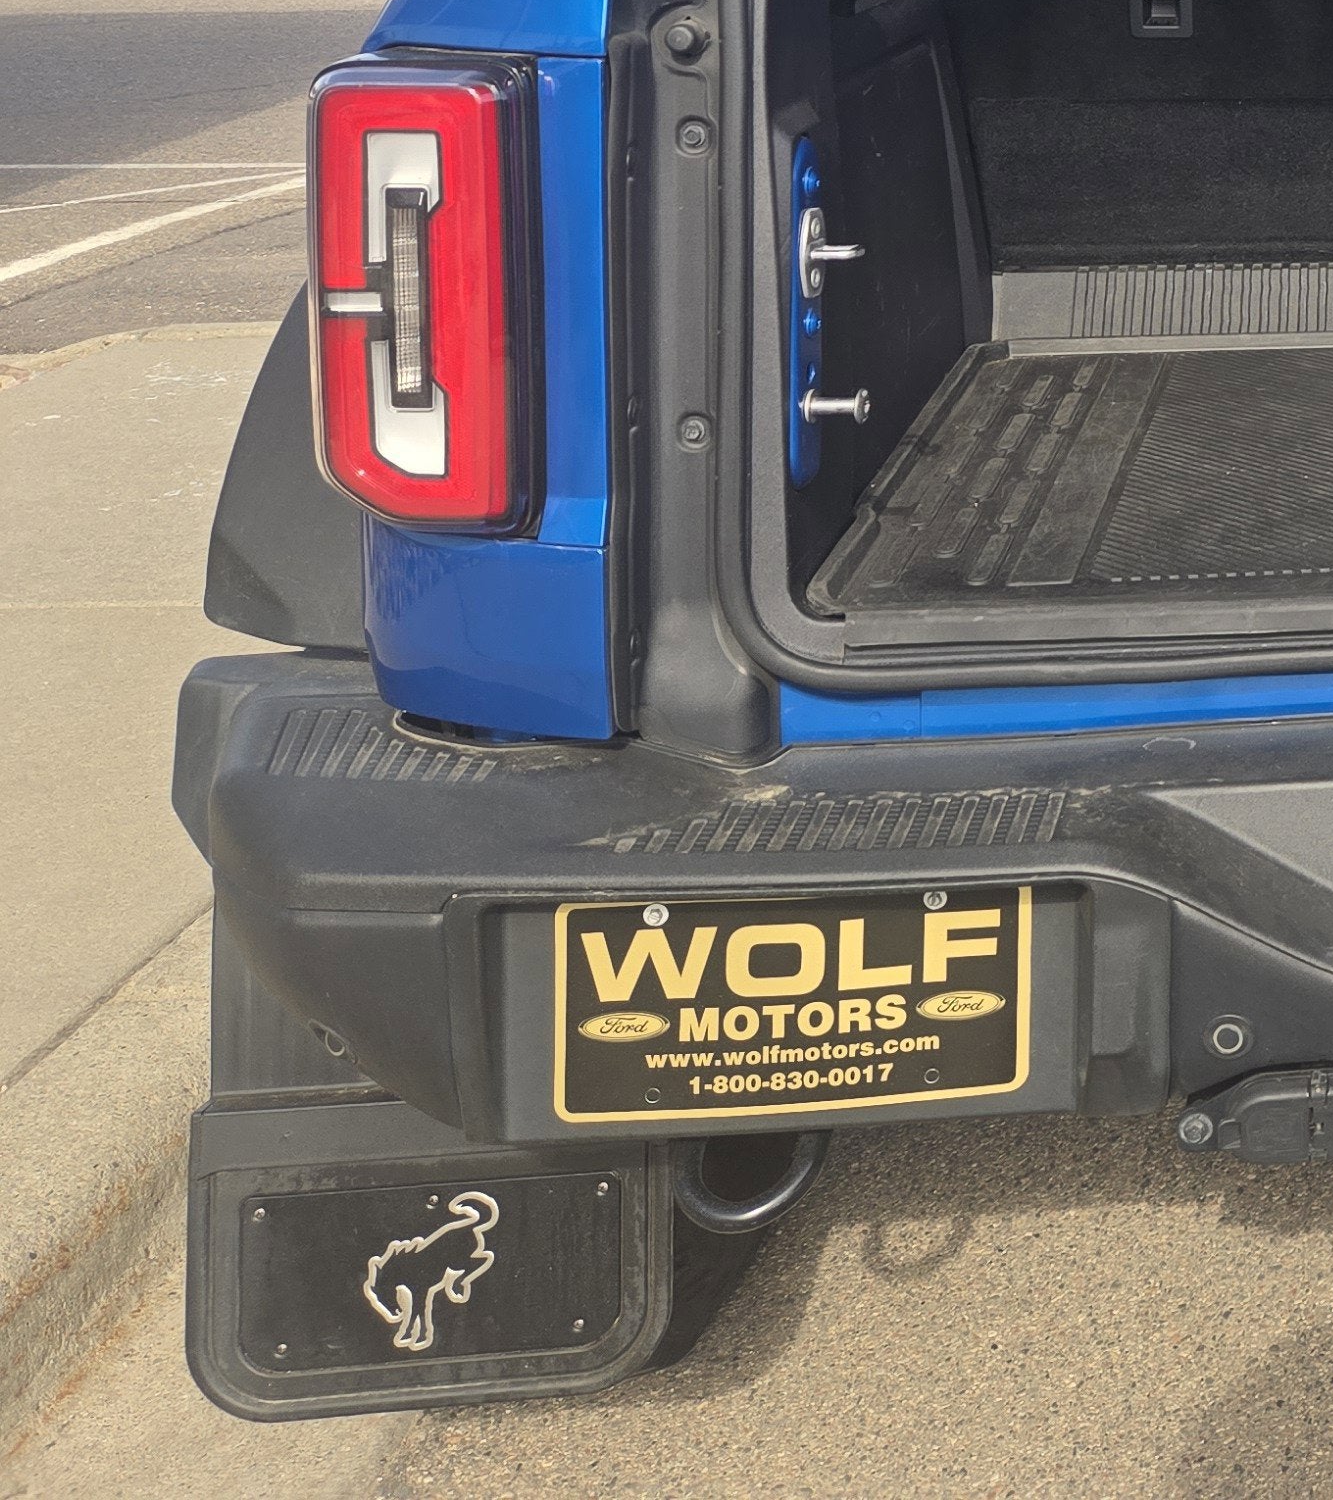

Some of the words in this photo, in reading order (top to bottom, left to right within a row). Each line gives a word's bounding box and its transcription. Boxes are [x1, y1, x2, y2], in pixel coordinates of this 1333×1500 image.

[580, 909, 1001, 1002] WOLF
[679, 994, 907, 1042] MOTORS
[937, 996, 984, 1013] Ford
[600, 1017, 648, 1034] Ford
[645, 1033, 940, 1069] www.wolfmotors.com
[689, 1063, 893, 1095] 1-800-830-0017
